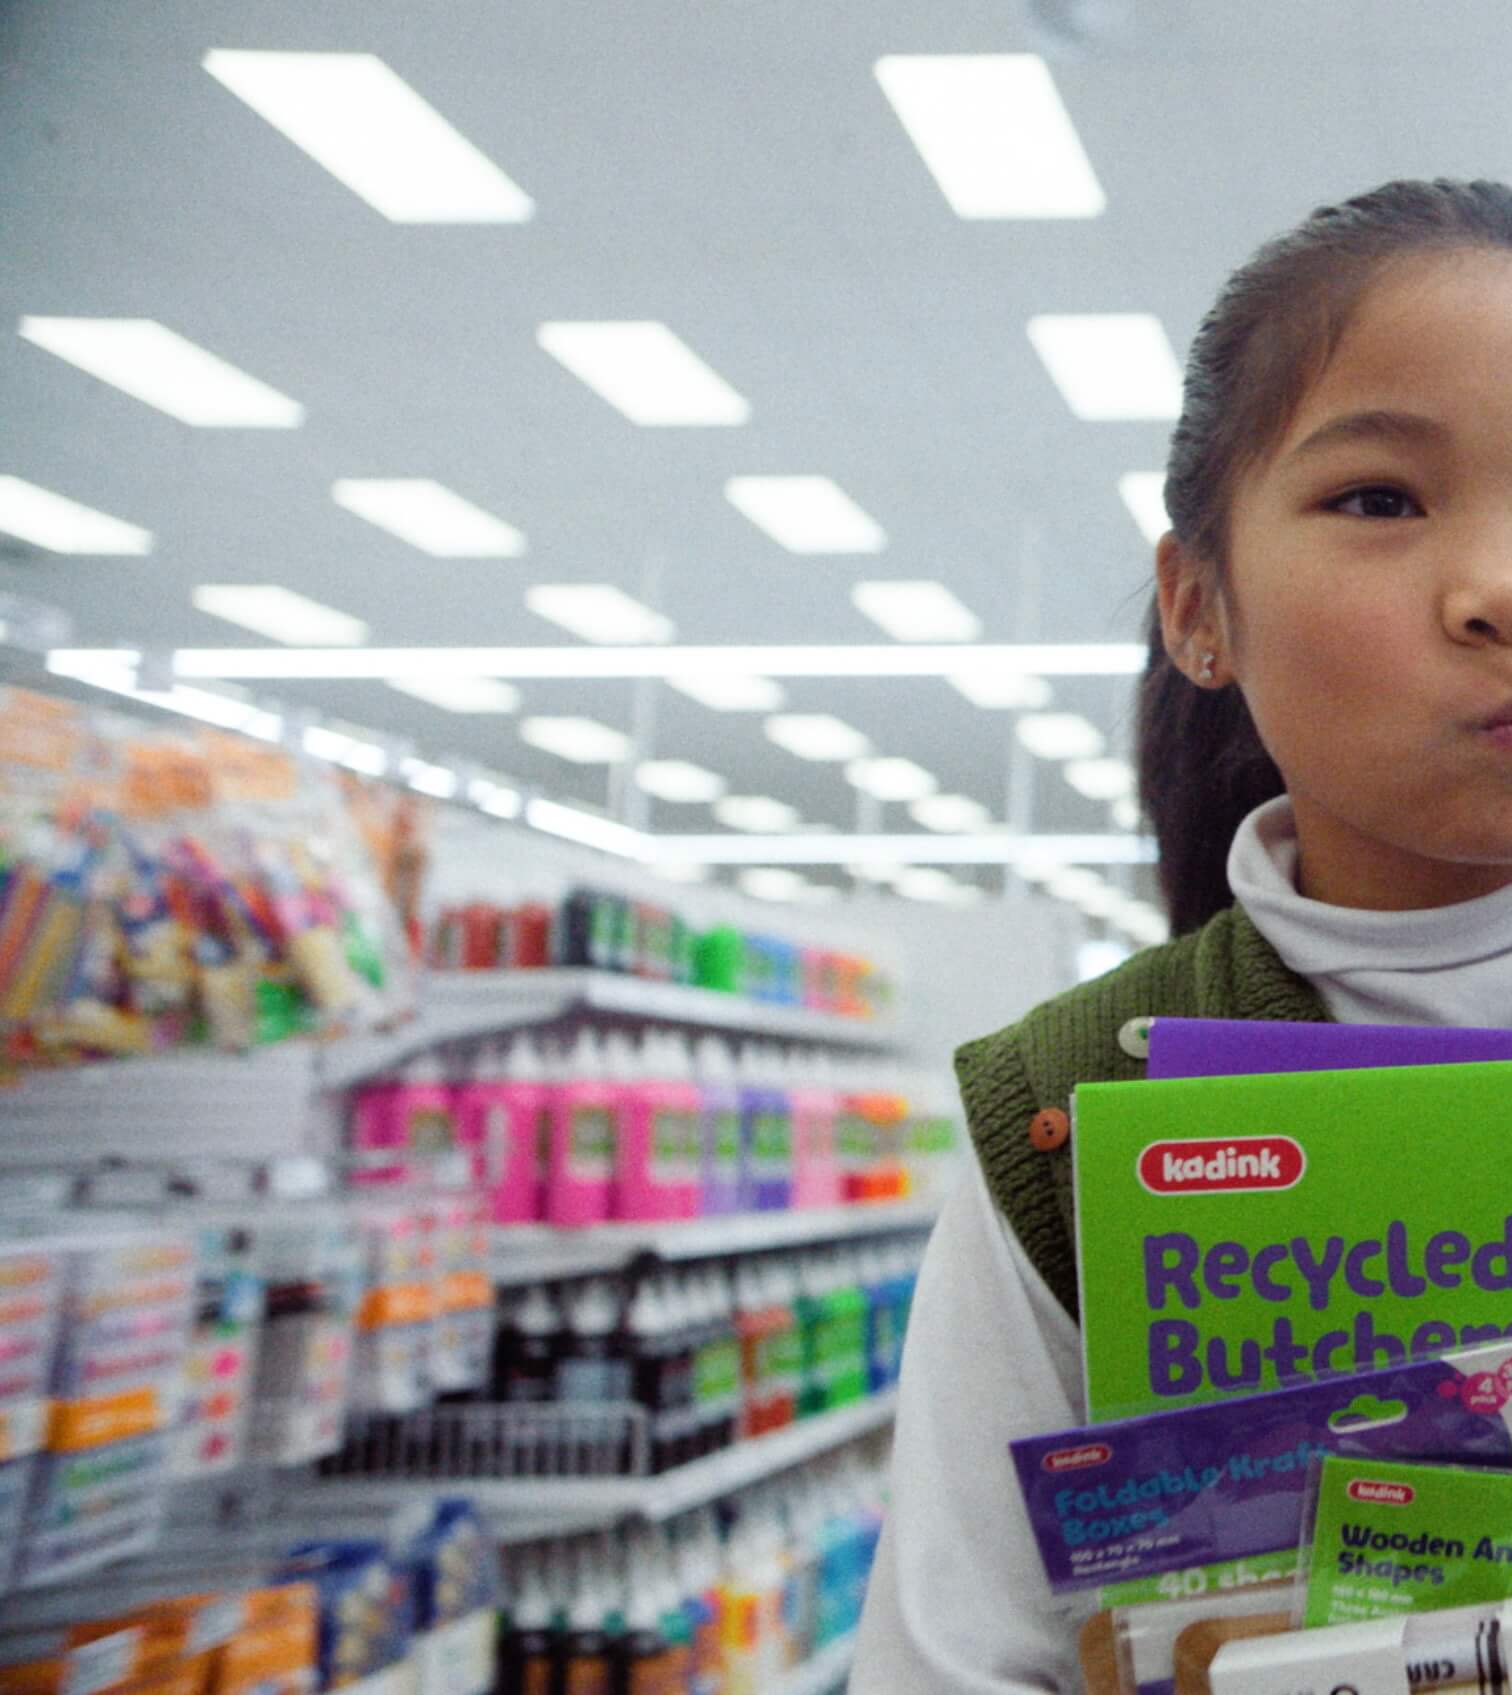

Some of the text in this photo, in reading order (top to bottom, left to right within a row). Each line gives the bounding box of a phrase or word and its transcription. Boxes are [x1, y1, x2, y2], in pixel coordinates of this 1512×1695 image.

[1162, 1147, 1282, 1182] kadink
[1477, 1377, 1494, 1395] 4
[1053, 1465, 1222, 1517] Foldable
[1061, 1506, 1170, 1546] Boxes
[1340, 1523, 1465, 1559] Wooden
[1156, 1566, 1208, 1599] 40
[1337, 1550, 1446, 1587] Shapes
